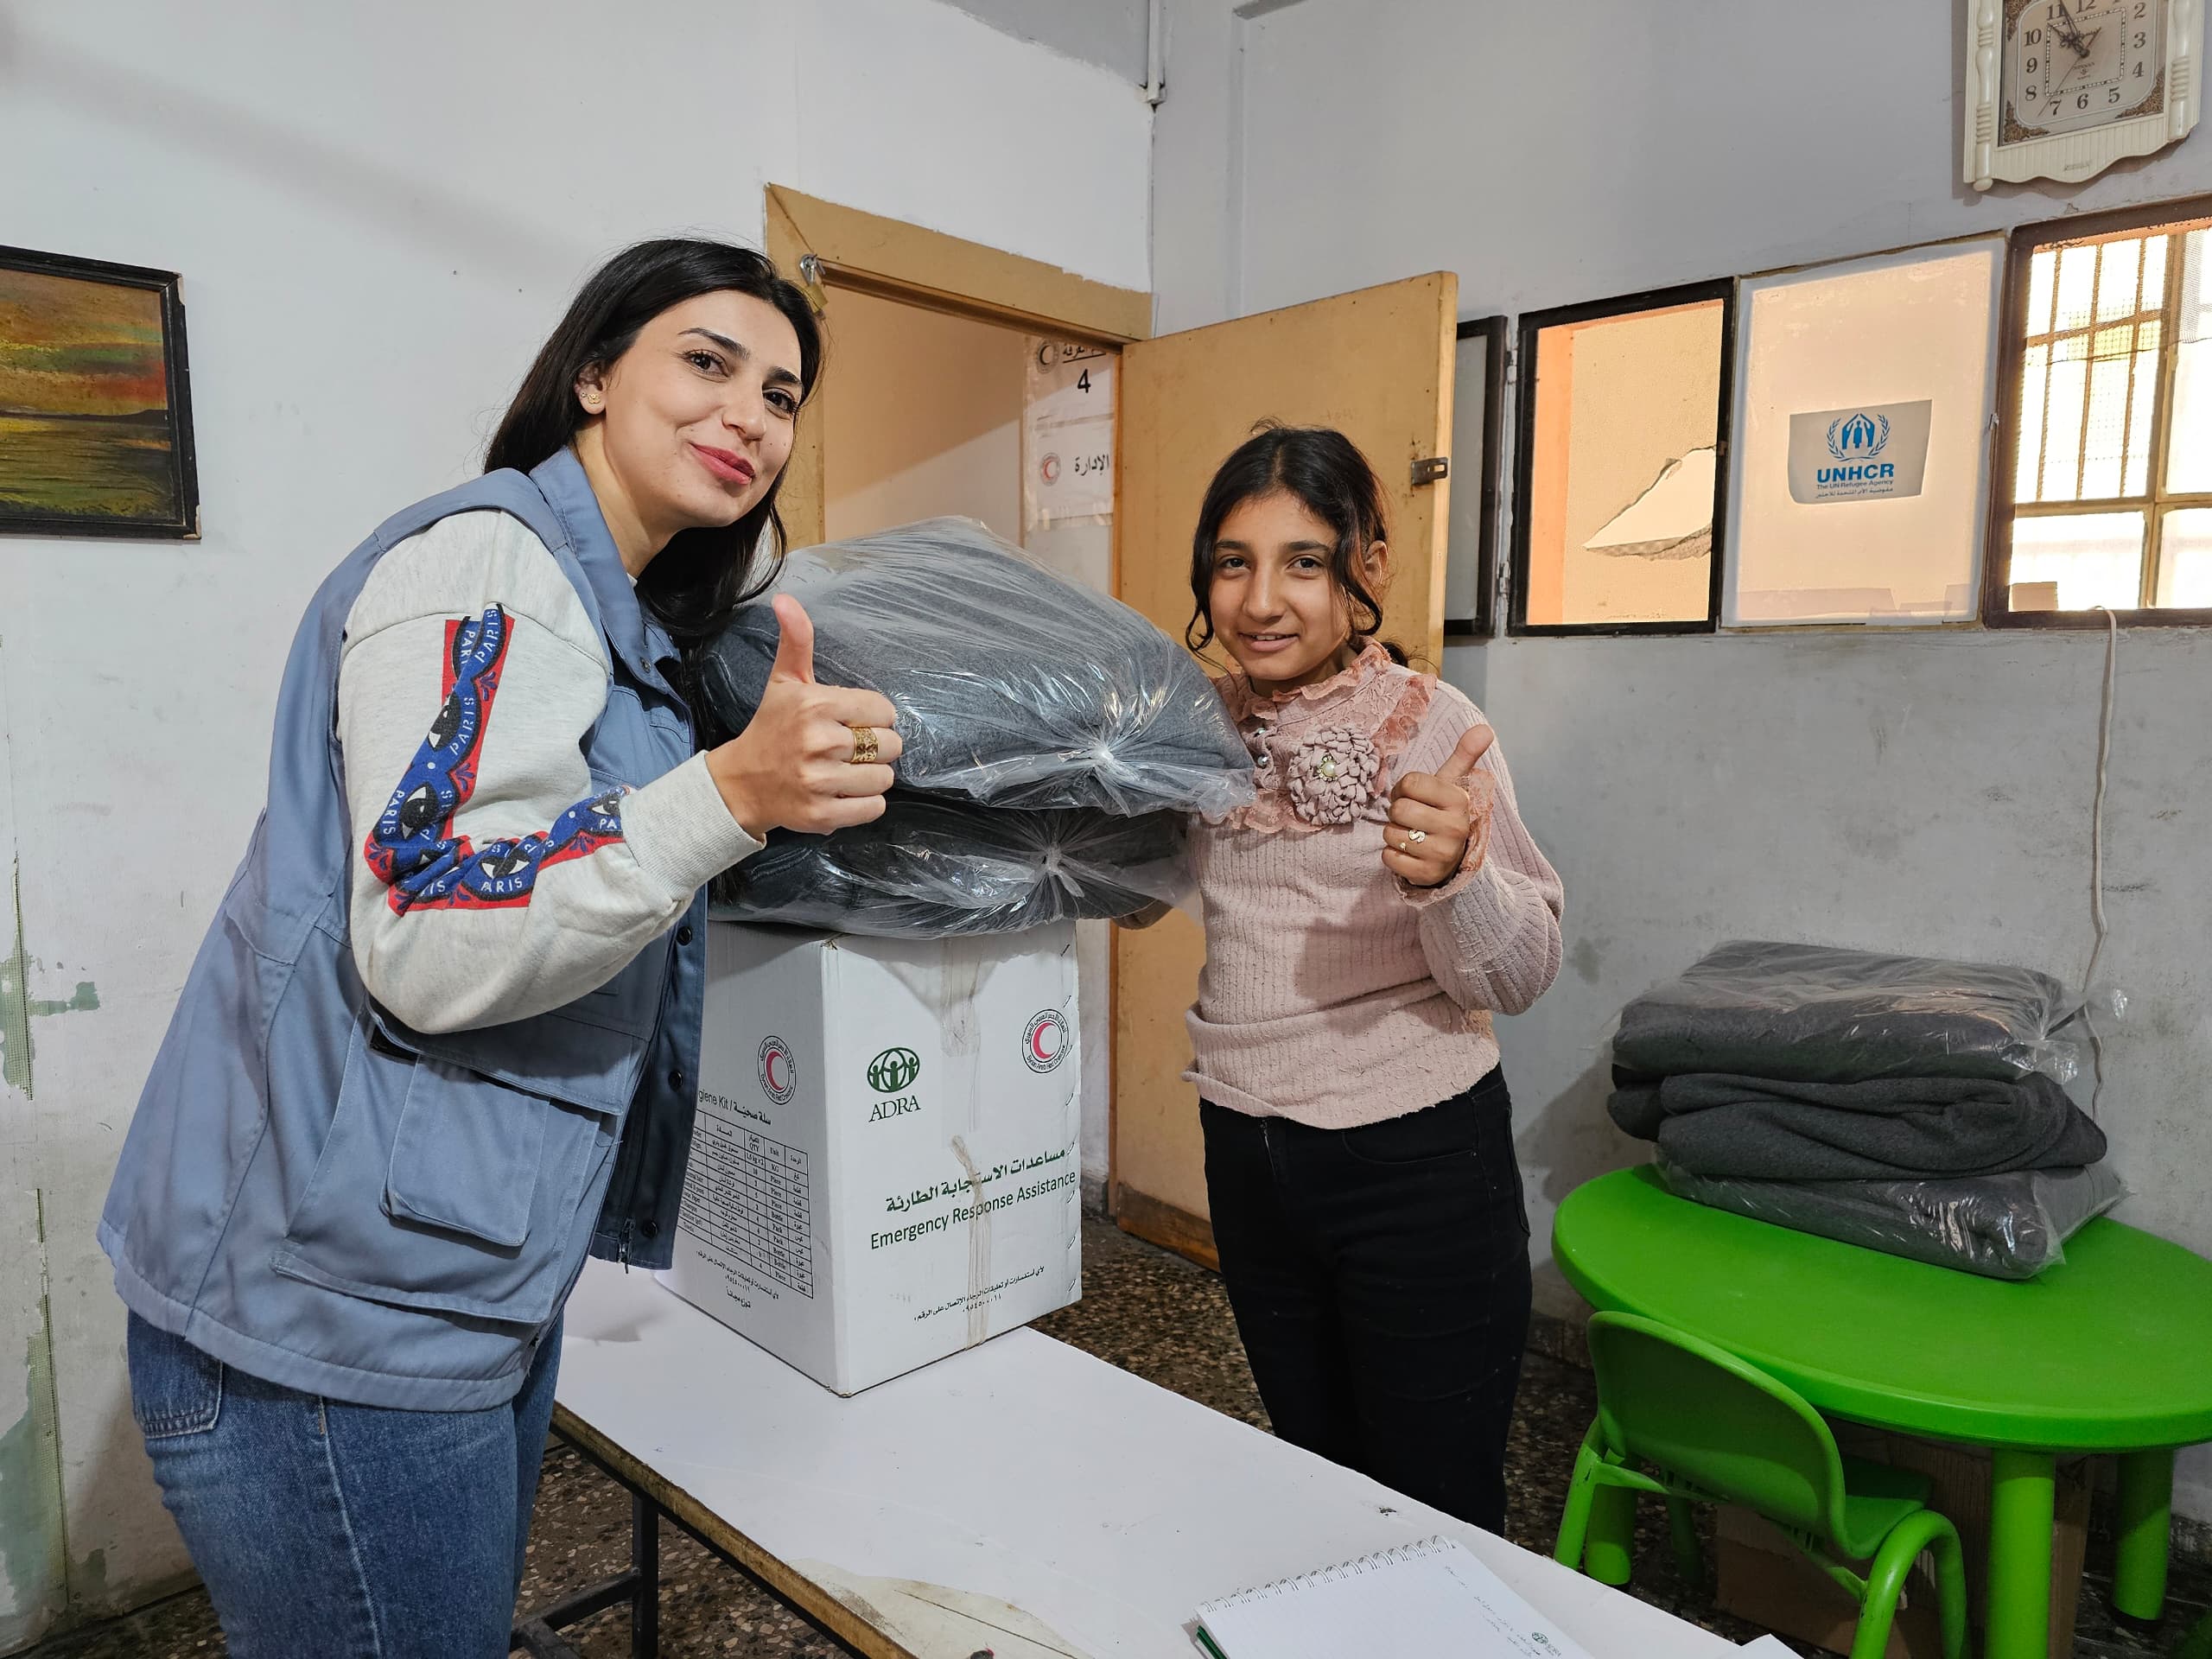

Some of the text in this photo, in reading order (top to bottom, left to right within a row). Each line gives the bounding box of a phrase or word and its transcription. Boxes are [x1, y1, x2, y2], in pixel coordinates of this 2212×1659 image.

[2047, 3, 2066, 20] 11
[2133, 3, 2146, 19] 2
[2024, 29, 2042, 47] 10
[2133, 31, 2146, 48] 3
[2025, 57, 2037, 73] 9
[2132, 61, 2145, 79] 4
[2025, 85, 2037, 101] 8
[2076, 92, 2088, 110] 6
[2107, 87, 2121, 104] 5
[2050, 100, 2062, 116] 7
[1077, 368, 1091, 394] 4
[1074, 453, 1109, 476] الإدارة
[1816, 463, 1895, 484] UNHCR
[474, 610, 499, 664] PARIS
[449, 697, 475, 756] PARIS
[382, 790, 405, 835] PARIS
[698, 1089, 718, 1106] giene
[718, 1095, 728, 1110] Kit
[868, 1095, 921, 1122] ADRA
[885, 1148, 1065, 1212] مساعدات الاستجابة الطارئة
[870, 1171, 1076, 1250] Emergency Response Assistance
